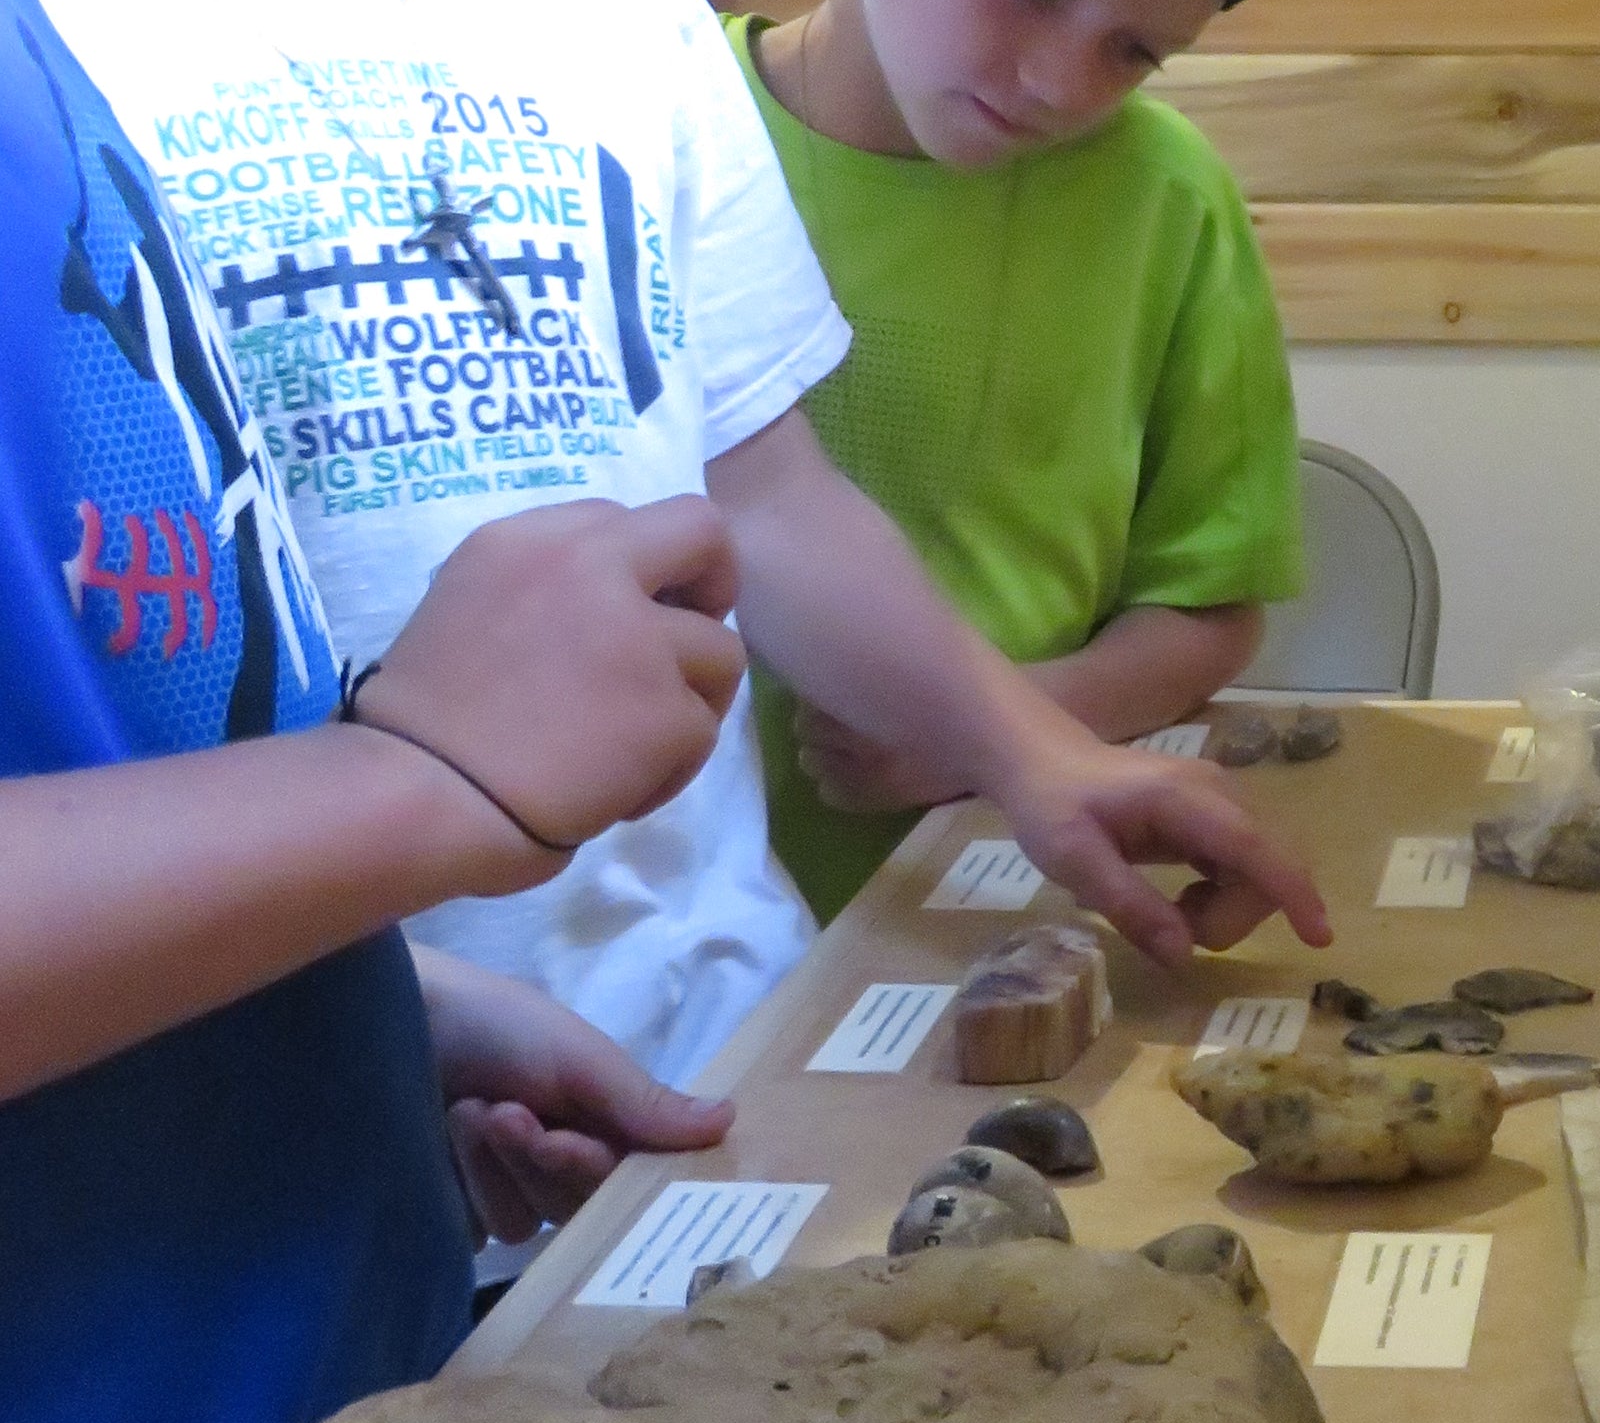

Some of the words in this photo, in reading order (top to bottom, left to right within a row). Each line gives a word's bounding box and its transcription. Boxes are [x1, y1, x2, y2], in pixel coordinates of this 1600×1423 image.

[213, 78, 282, 102] PUNT
[289, 58, 459, 88] OVERTIME
[308, 87, 408, 110] COACH
[420, 89, 550, 138] 2015
[154, 101, 310, 161] KICKOFF
[323, 118, 415, 139] SKILLS
[421, 138, 586, 180] SAFETY
[341, 185, 444, 228] RED
[455, 182, 588, 228] ZONE
[262, 215, 351, 249] TEAM
[329, 308, 590, 362] WOLFPACK
[384, 349, 618, 398] FOOTBALL
[290, 398, 458, 461] SKILLS
[468, 391, 587, 435] CAMP
[474, 432, 554, 463] FIELD
[560, 431, 624, 457] GOAL
[284, 457, 359, 499] PIG
[369, 439, 468, 483] SKIN
[321, 483, 401, 518] FIRST
[411, 474, 490, 503] DOWN
[496, 464, 590, 492] FUMBLE
